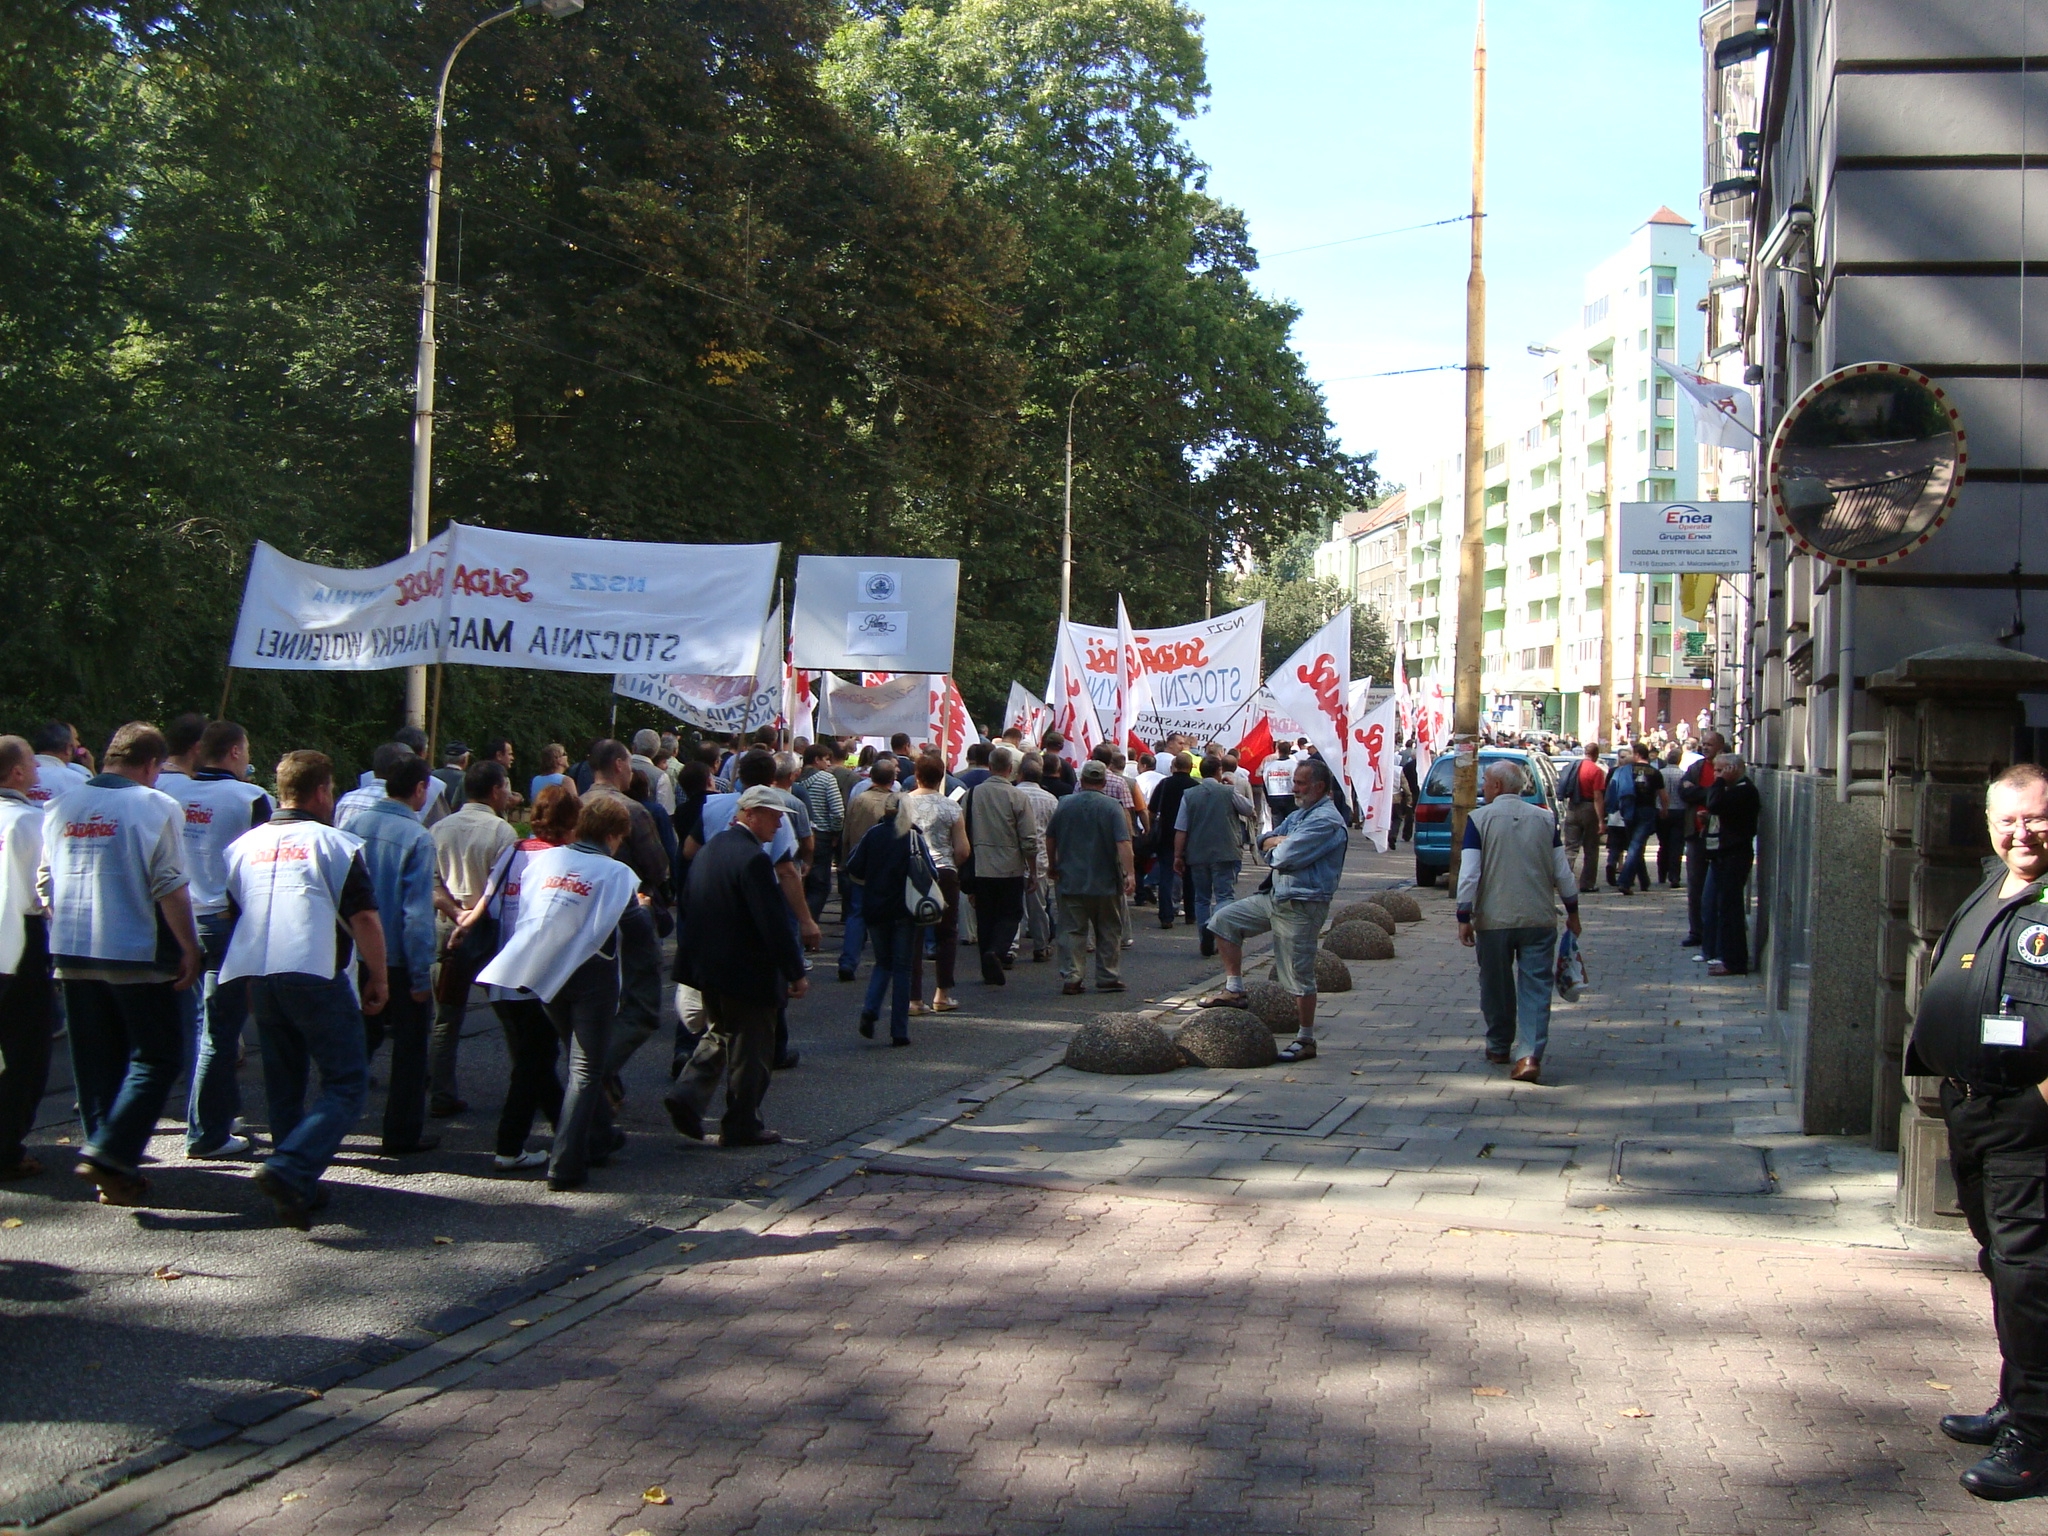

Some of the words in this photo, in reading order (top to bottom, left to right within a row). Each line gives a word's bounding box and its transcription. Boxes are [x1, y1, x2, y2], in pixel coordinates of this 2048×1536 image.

[1665, 511, 1713, 524] Enea
[1678, 523, 1712, 531] Operator
[1658, 533, 1686, 542] Grupa
[1687, 532, 1712, 540] Enea
